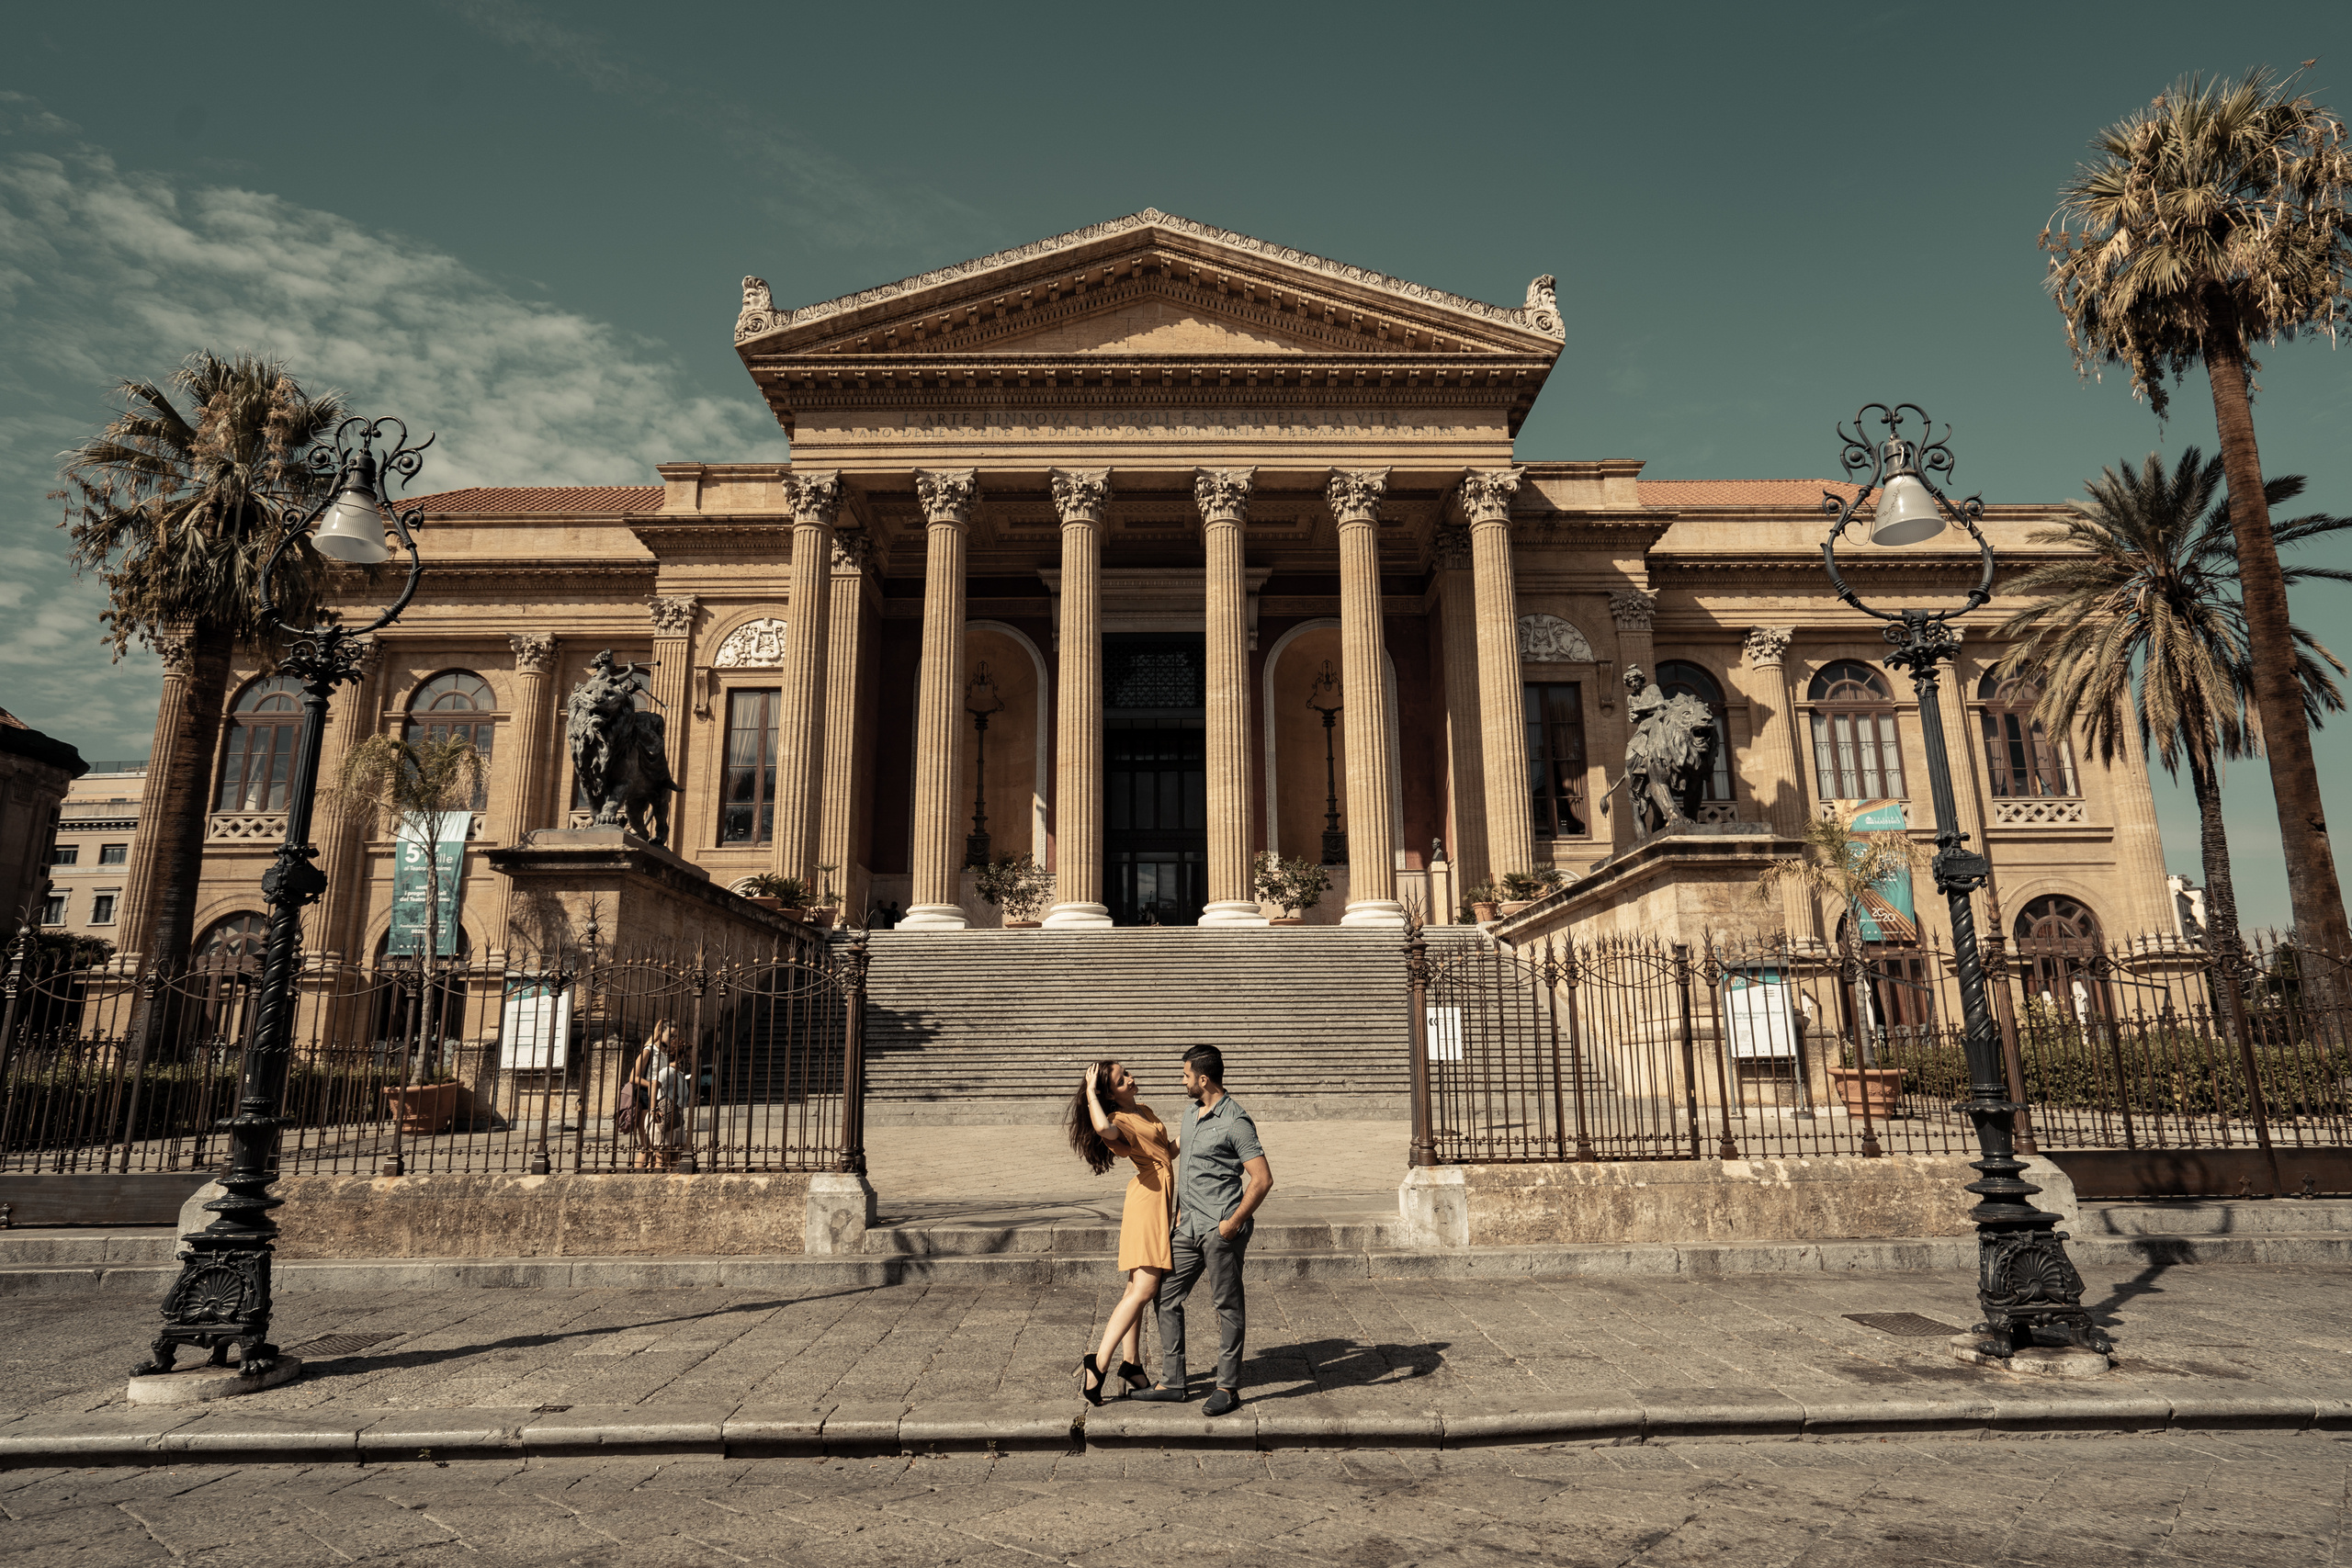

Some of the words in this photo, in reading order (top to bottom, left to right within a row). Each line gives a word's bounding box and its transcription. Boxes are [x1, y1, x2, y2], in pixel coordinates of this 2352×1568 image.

[904, 412, 971, 425] L'ARTE
[983, 412, 1073, 425] RINNOVA
[1102, 412, 1170, 424] POPOLI
[1182, 412, 1191, 424] E
[1203, 412, 1227, 424] NE
[1240, 412, 1310, 424] RIVELA
[1324, 412, 1344, 424] LA
[1355, 412, 1401, 424] VITA
[850, 427, 891, 438] VANO
[902, 427, 945, 437] DELLE
[957, 427, 1012, 437] SCENE
[1023, 427, 1038, 436] IL
[1048, 426, 1113, 436] DILETTO
[1125, 426, 1154, 436] OVE
[1167, 426, 1200, 436] NON
[1215, 426, 1250, 436] MIRI
[1278, 426, 1358, 436] PREPARAR
[1370, 426, 1457, 436] L'AVVENIRE
[404, 842, 420, 863] 5
